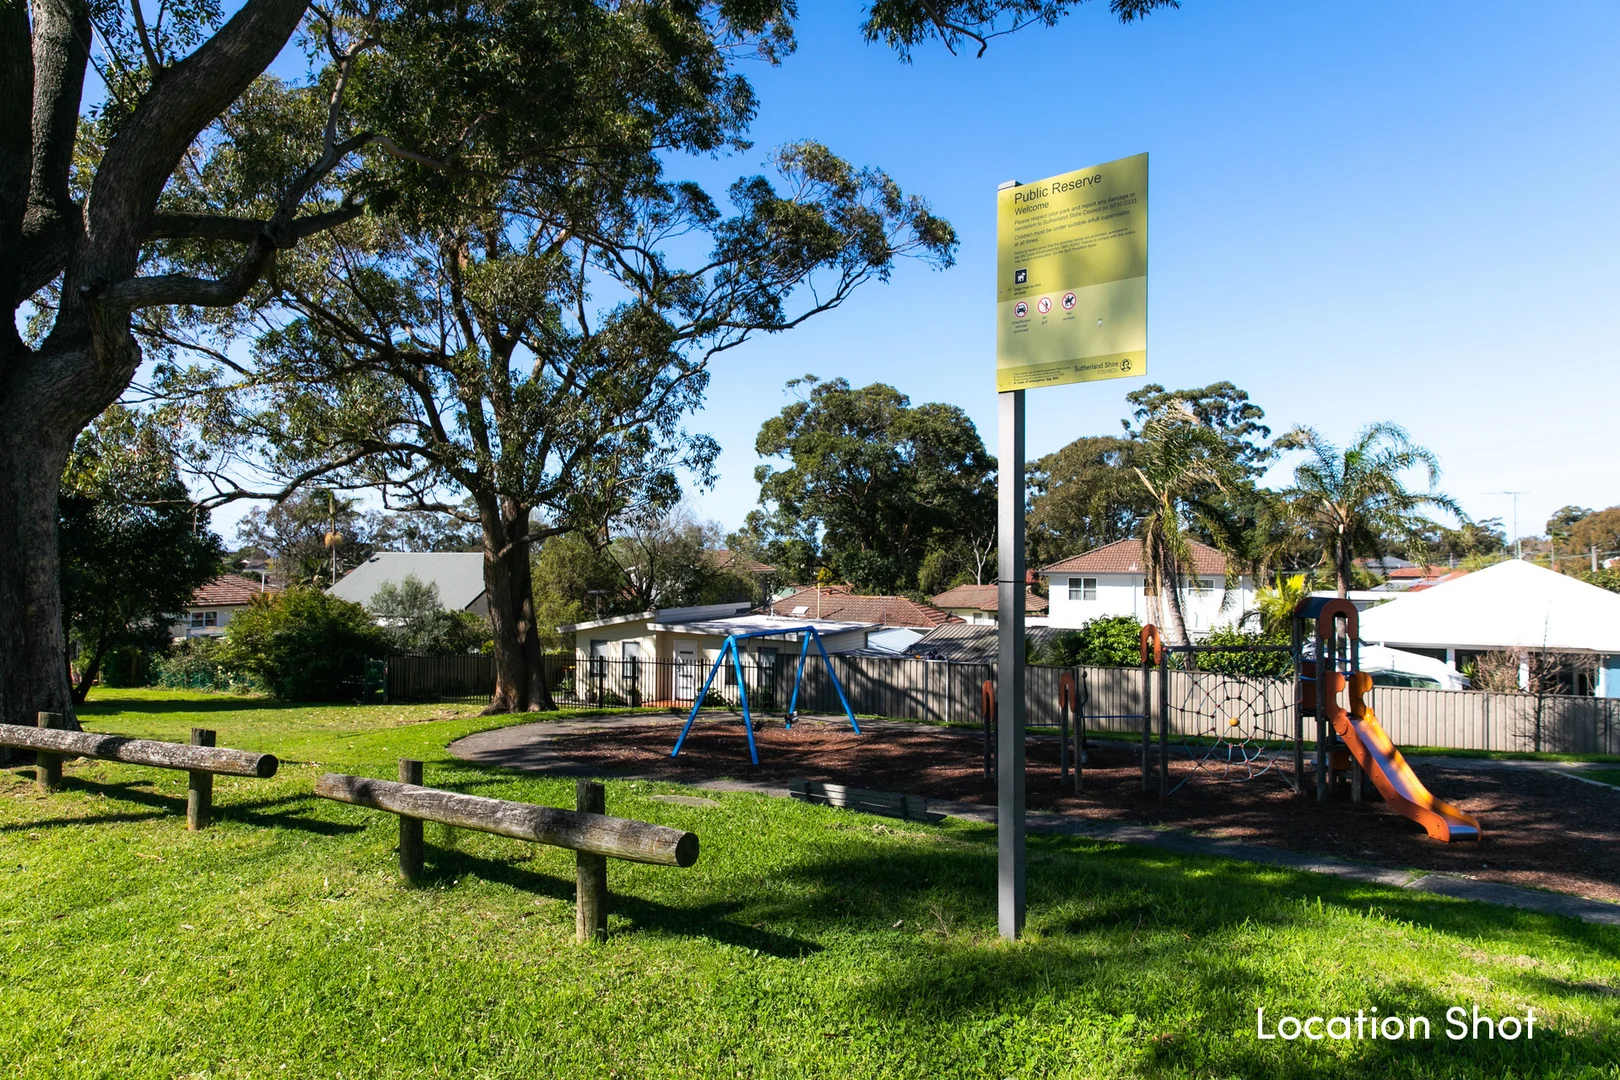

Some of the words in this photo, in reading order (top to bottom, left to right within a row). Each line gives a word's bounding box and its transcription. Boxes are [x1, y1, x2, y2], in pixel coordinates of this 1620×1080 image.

[1014, 188, 1048, 204] Public
[1052, 174, 1102, 194] Reserve
[1014, 202, 1049, 216] Welcome
[1031, 214, 1047, 222] respect
[1108, 194, 1128, 203] damage
[1015, 222, 1036, 231] vandalism
[1043, 214, 1068, 224] Sutherland
[1101, 211, 1130, 221] supervision
[1074, 362, 1104, 372] Sutherland
[1104, 360, 1119, 368] Shire
